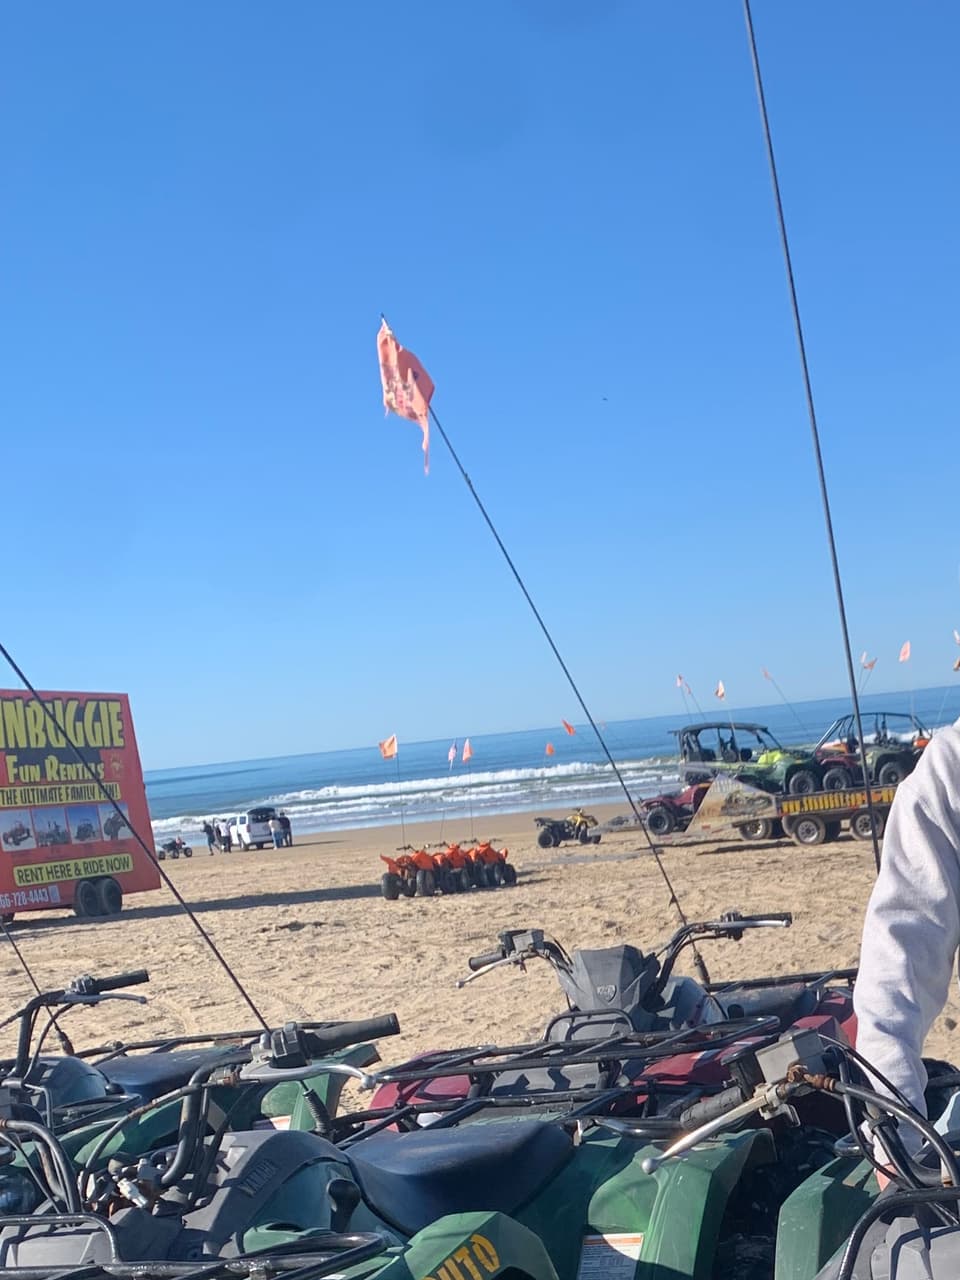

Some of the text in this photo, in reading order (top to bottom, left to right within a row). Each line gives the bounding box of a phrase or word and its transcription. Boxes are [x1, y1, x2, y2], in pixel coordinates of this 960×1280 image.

[0, 789, 18, 806] THE
[20, 786, 63, 804] ULTIMATE
[65, 783, 96, 801] FAMILY
[16, 856, 130, 884] RENT HERE & RIDE NOW
